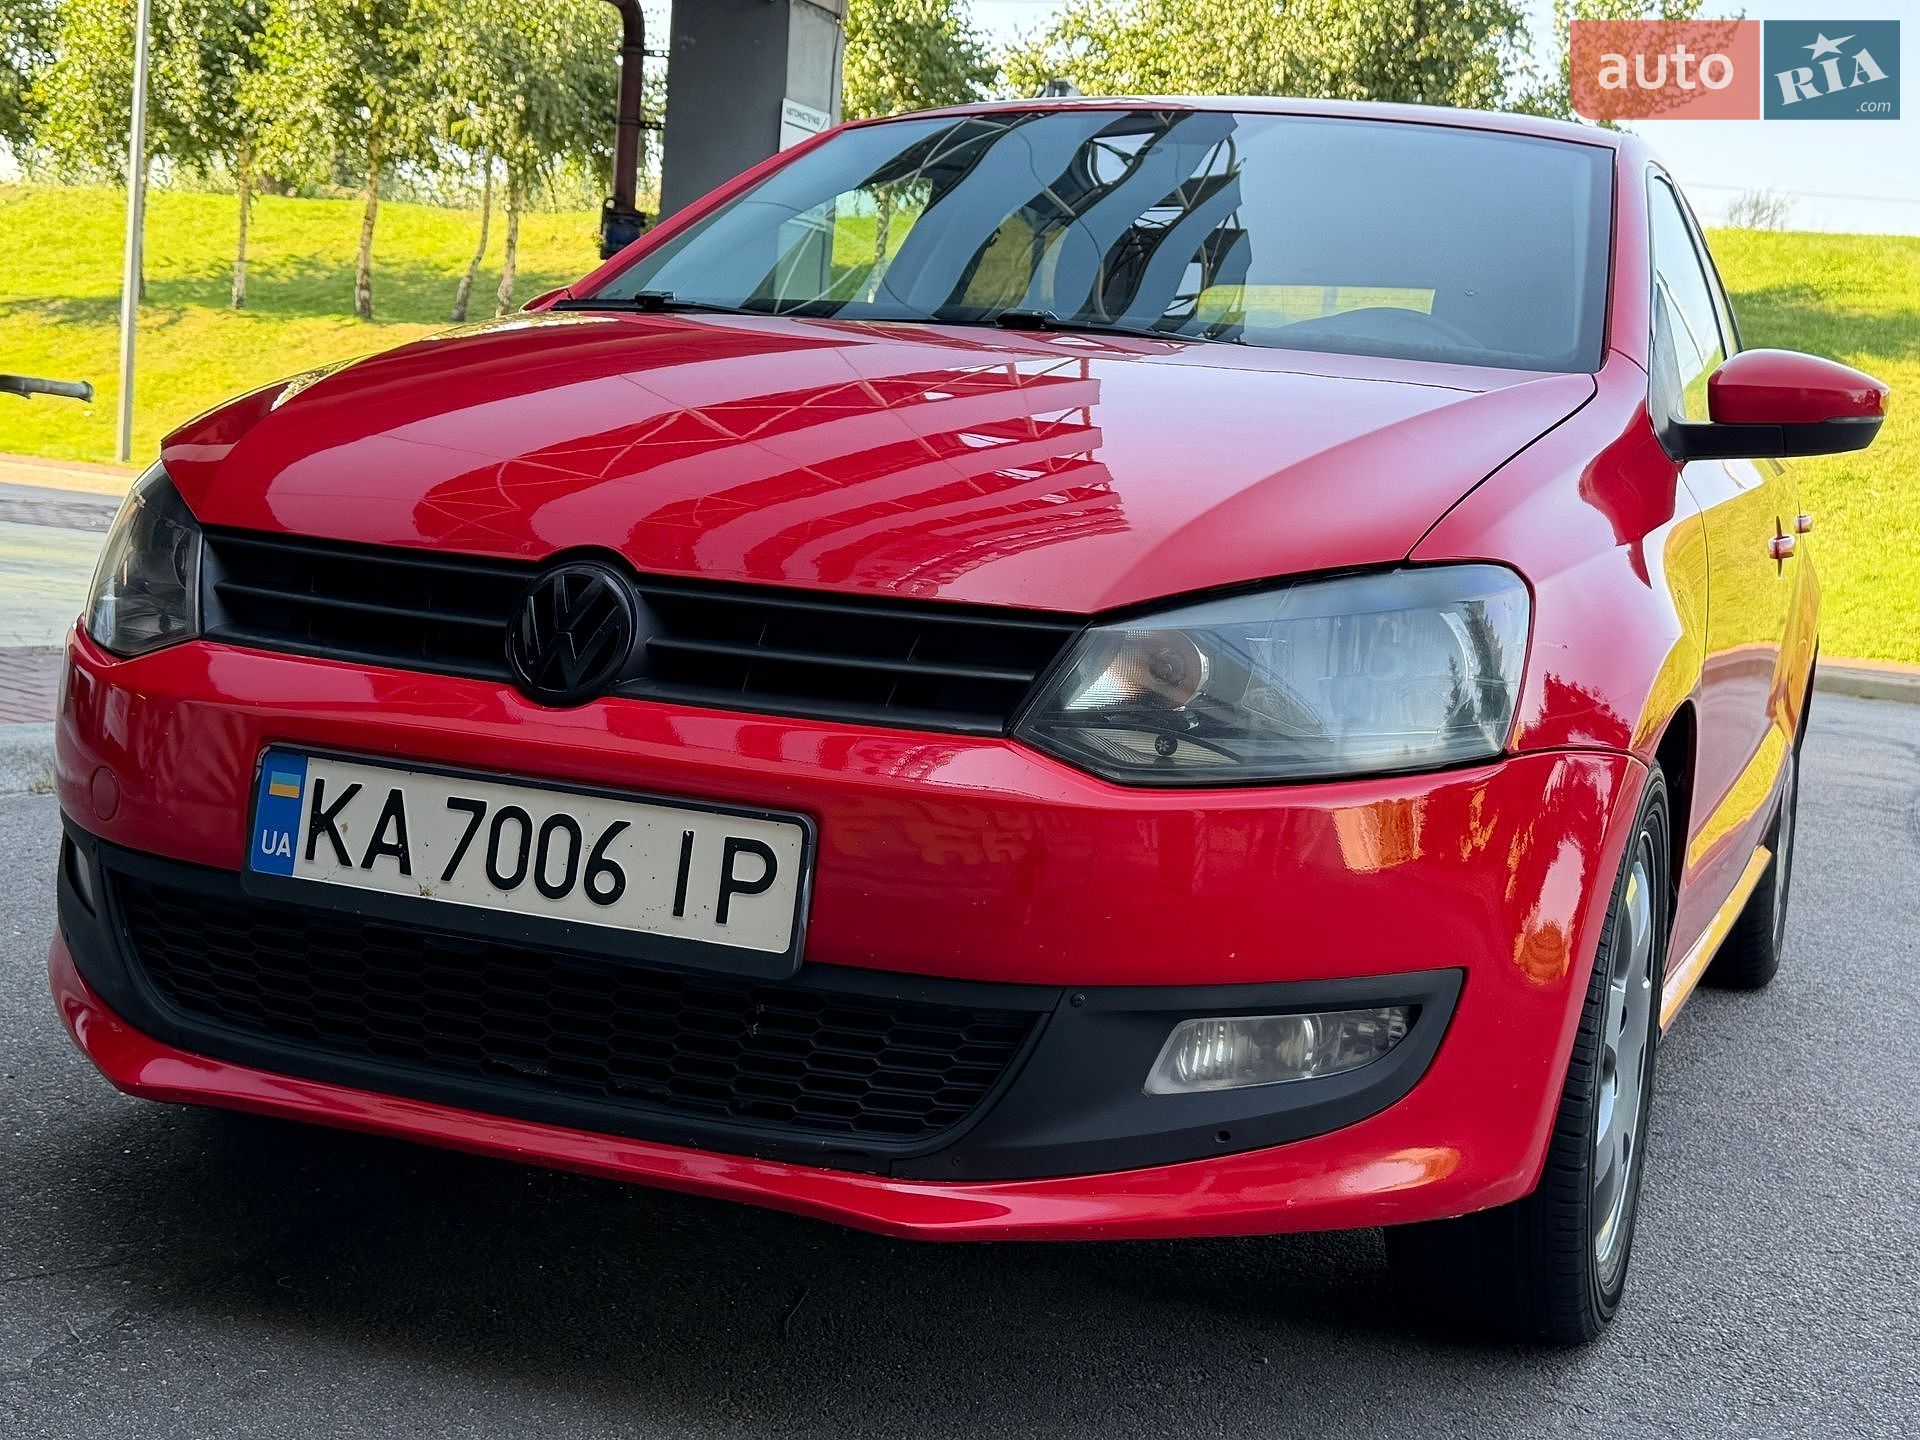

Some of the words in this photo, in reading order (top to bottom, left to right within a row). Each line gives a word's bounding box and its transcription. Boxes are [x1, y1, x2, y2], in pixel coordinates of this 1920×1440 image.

[261, 828, 292, 858] UA
[304, 777, 413, 876] KA
[440, 795, 633, 906] 7006
[671, 829, 779, 926] IP
